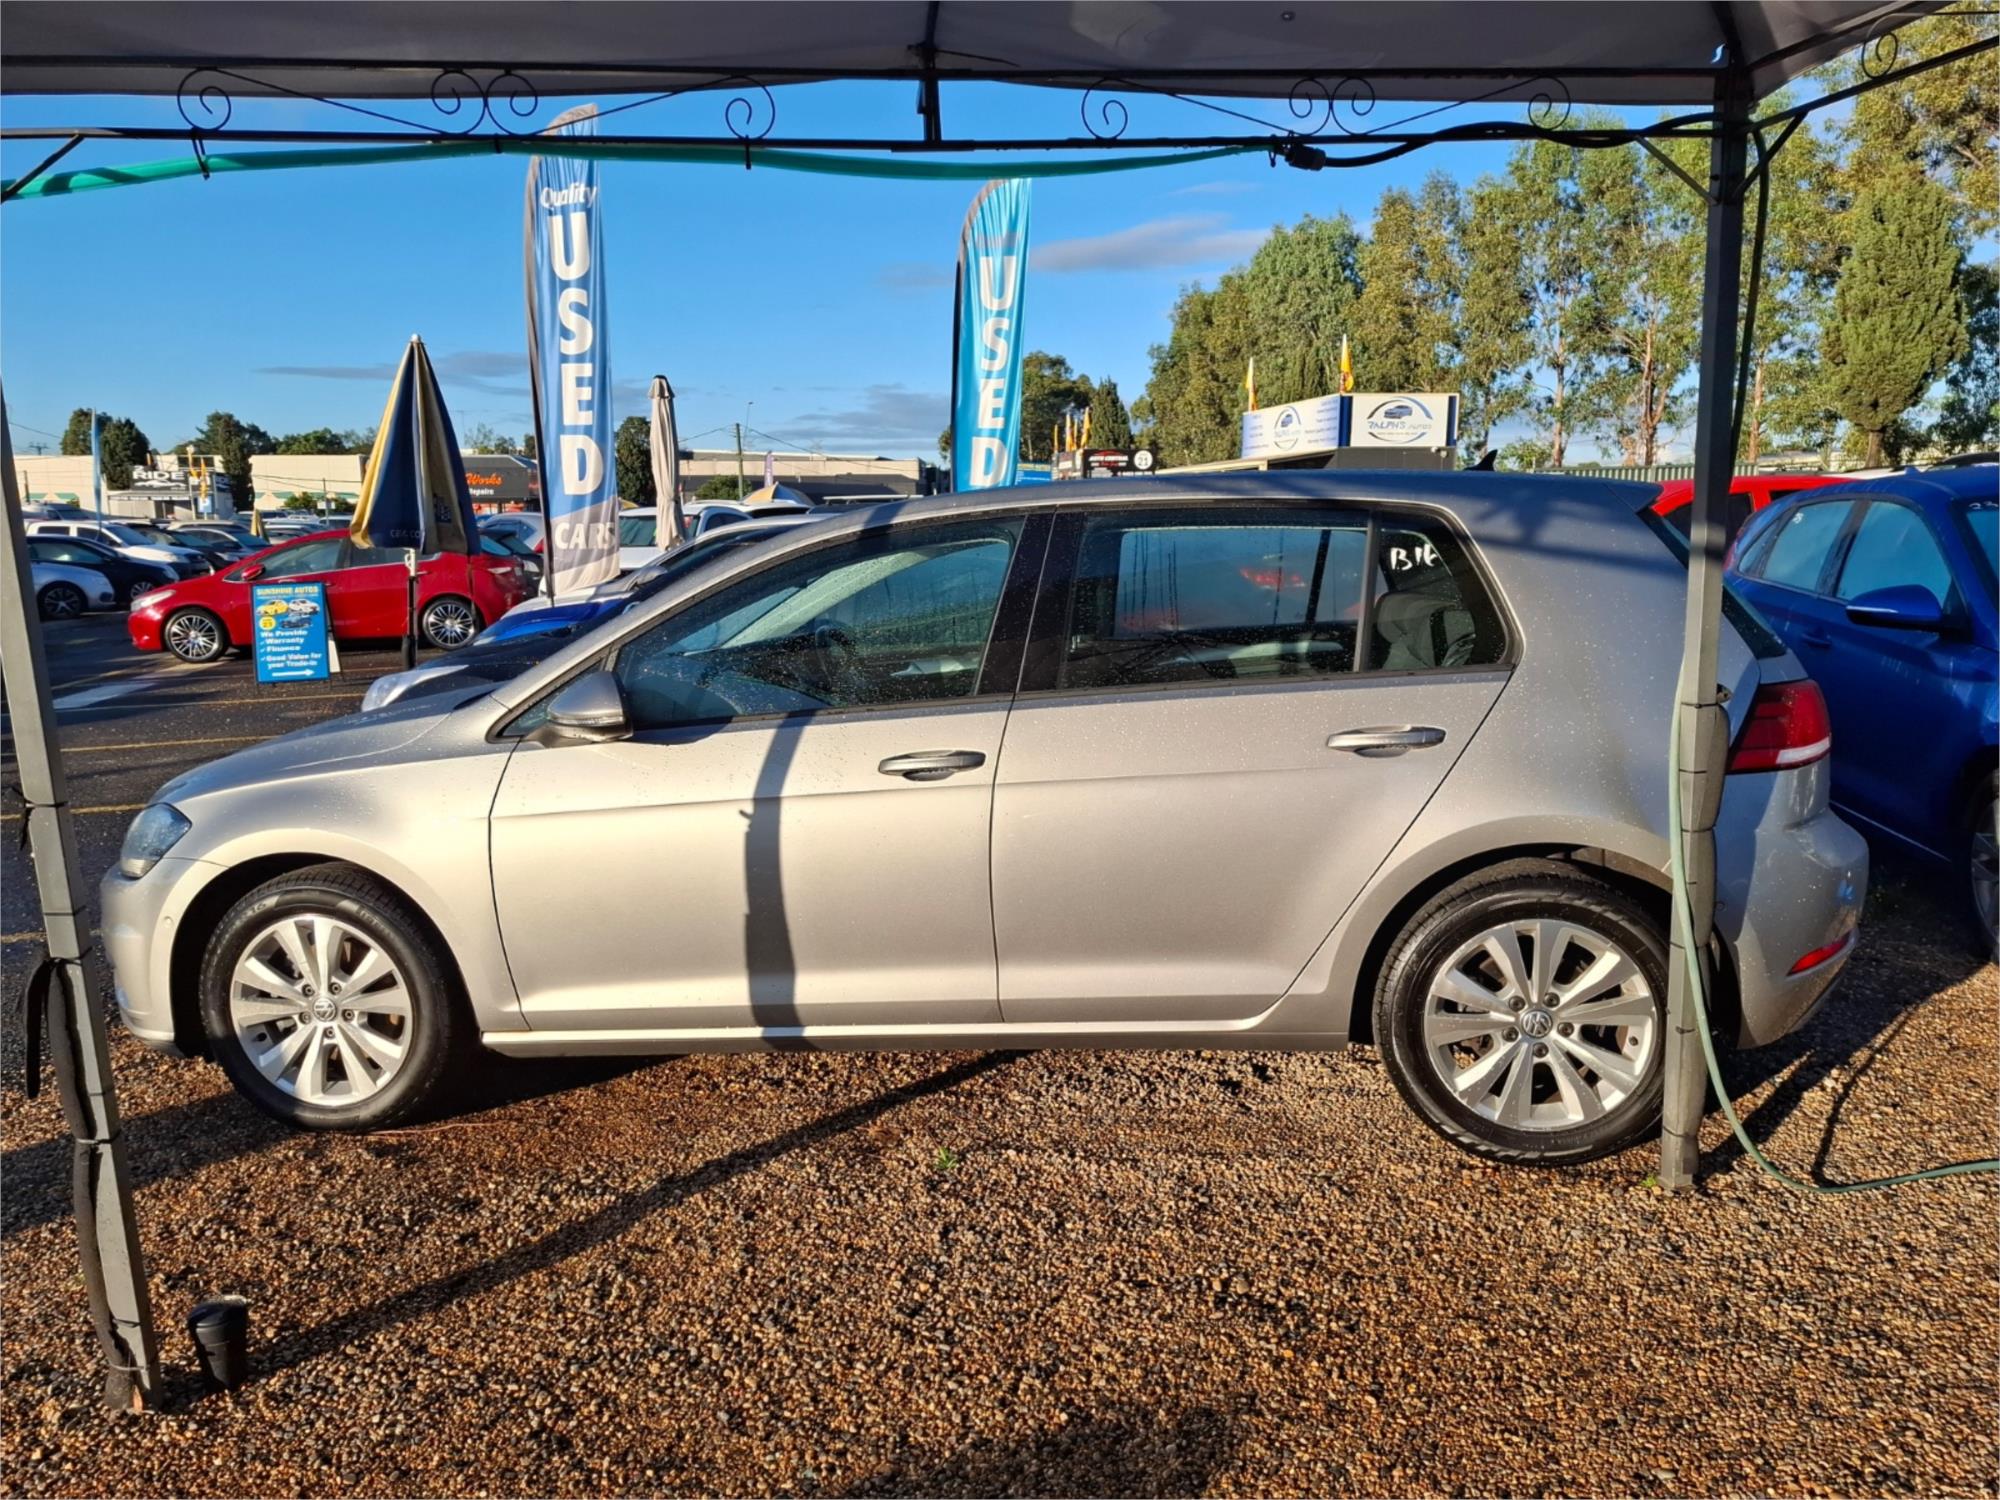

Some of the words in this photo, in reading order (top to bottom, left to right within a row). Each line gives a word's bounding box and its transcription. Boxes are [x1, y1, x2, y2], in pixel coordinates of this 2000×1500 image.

[540, 182, 597, 210] Quality
[550, 211, 604, 495] USED
[971, 256, 1015, 488] USED
[133, 471, 185, 480] RIDE
[554, 520, 615, 551] CARS
